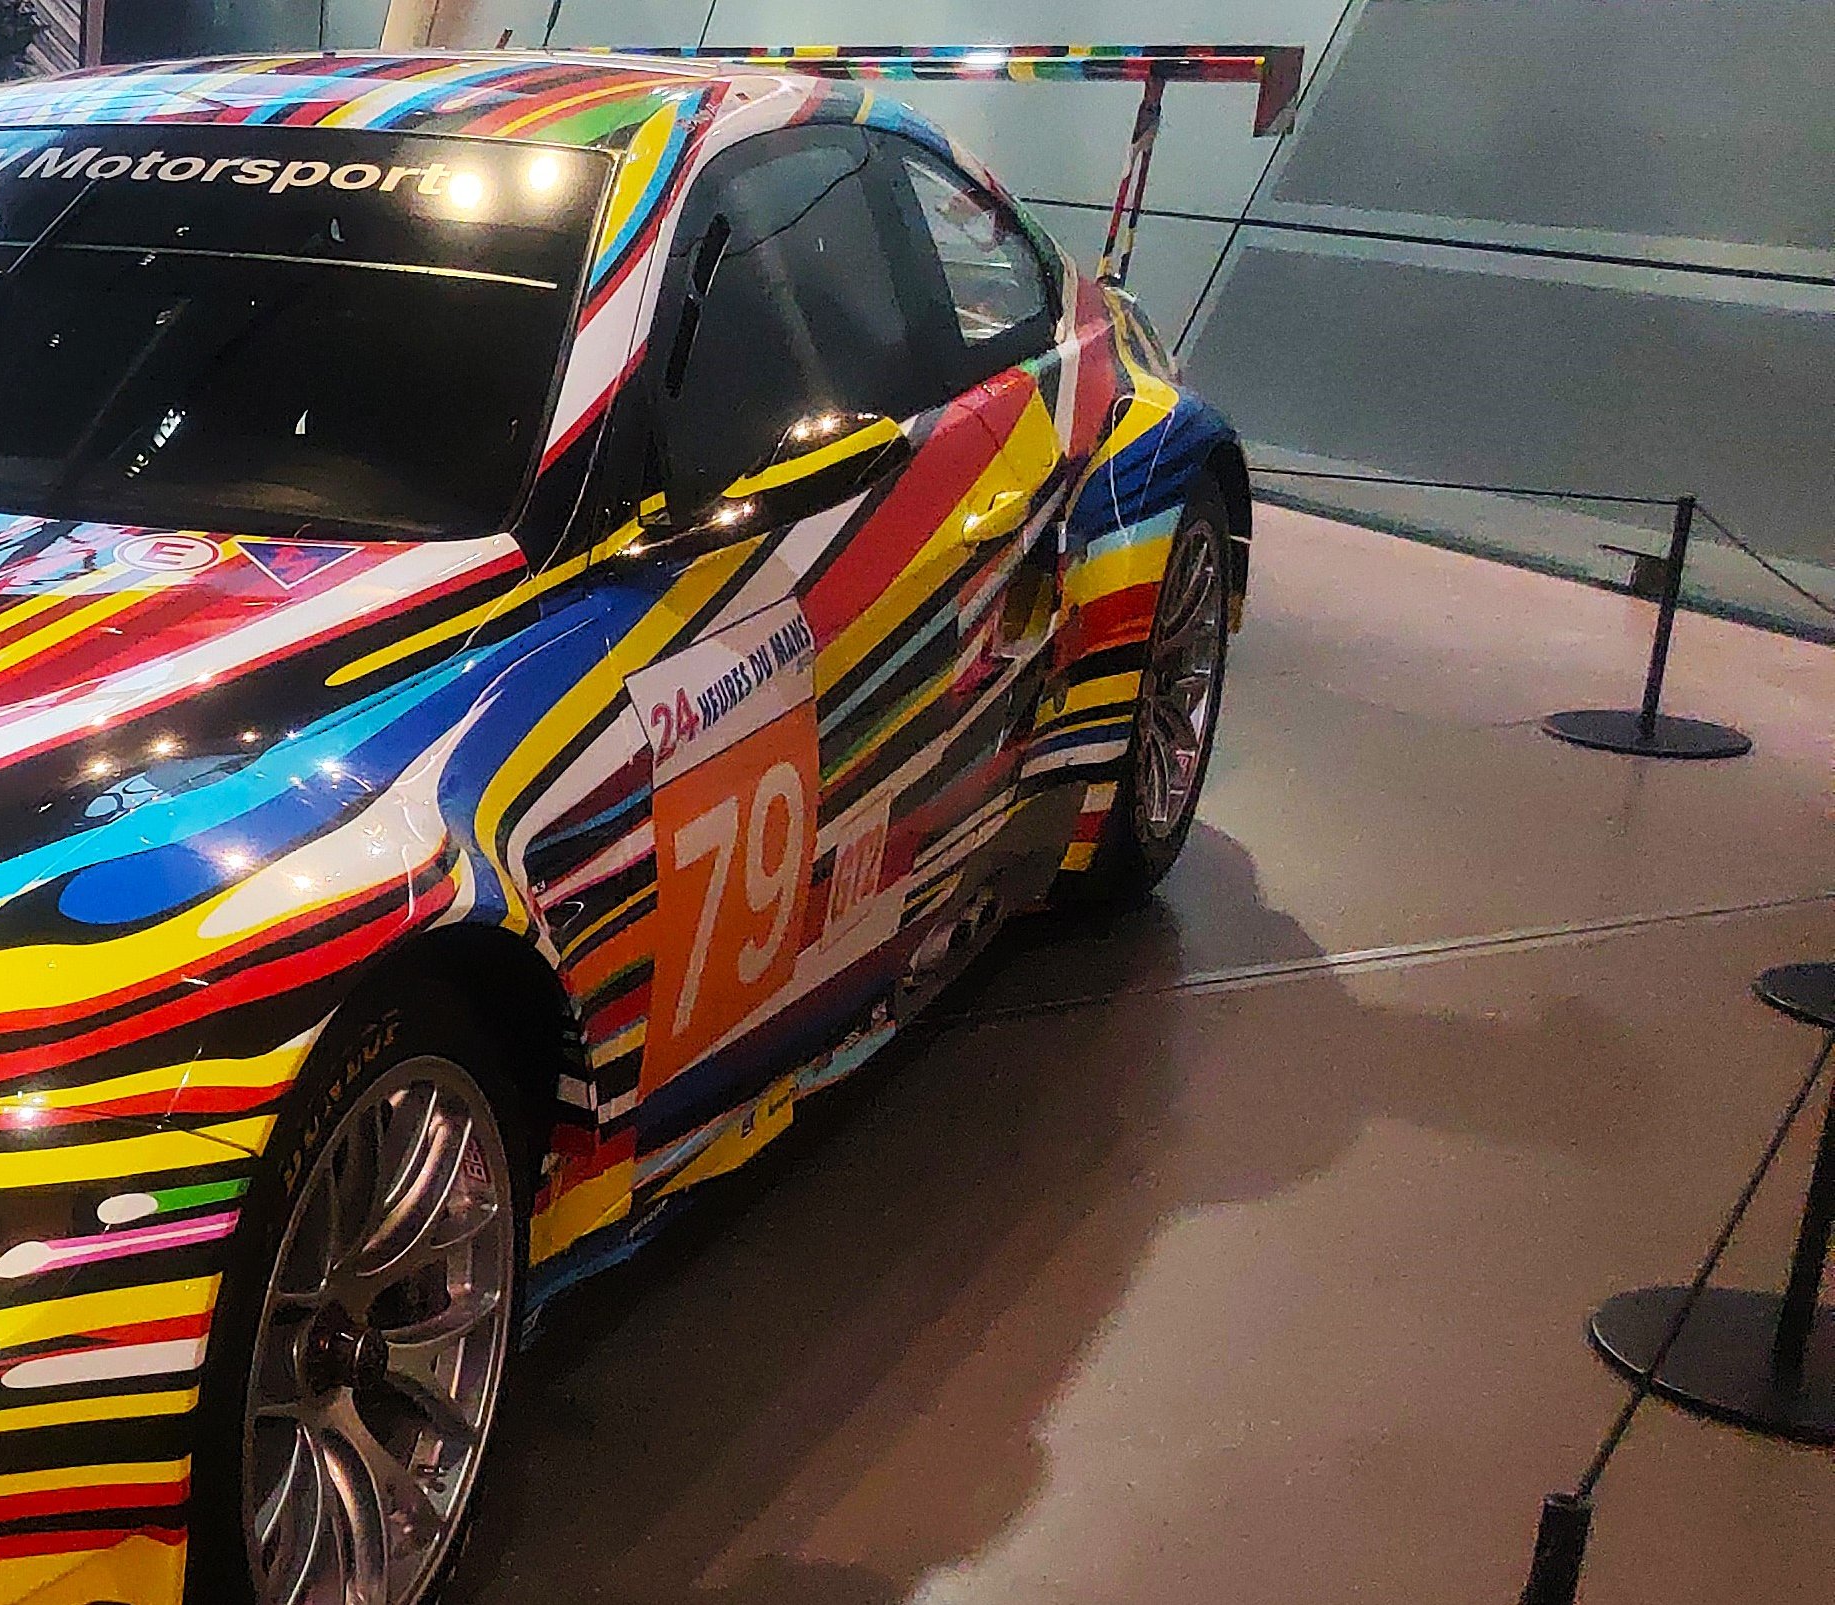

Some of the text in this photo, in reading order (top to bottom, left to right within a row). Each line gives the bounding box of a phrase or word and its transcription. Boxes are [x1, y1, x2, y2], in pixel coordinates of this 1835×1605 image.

[18, 147, 451, 194] Motorsport
[139, 541, 195, 565] E
[651, 687, 700, 768] 24
[697, 661, 752, 730] HEURES
[748, 645, 773, 687] DU
[769, 613, 811, 670] MANS
[673, 761, 804, 1037] 79
